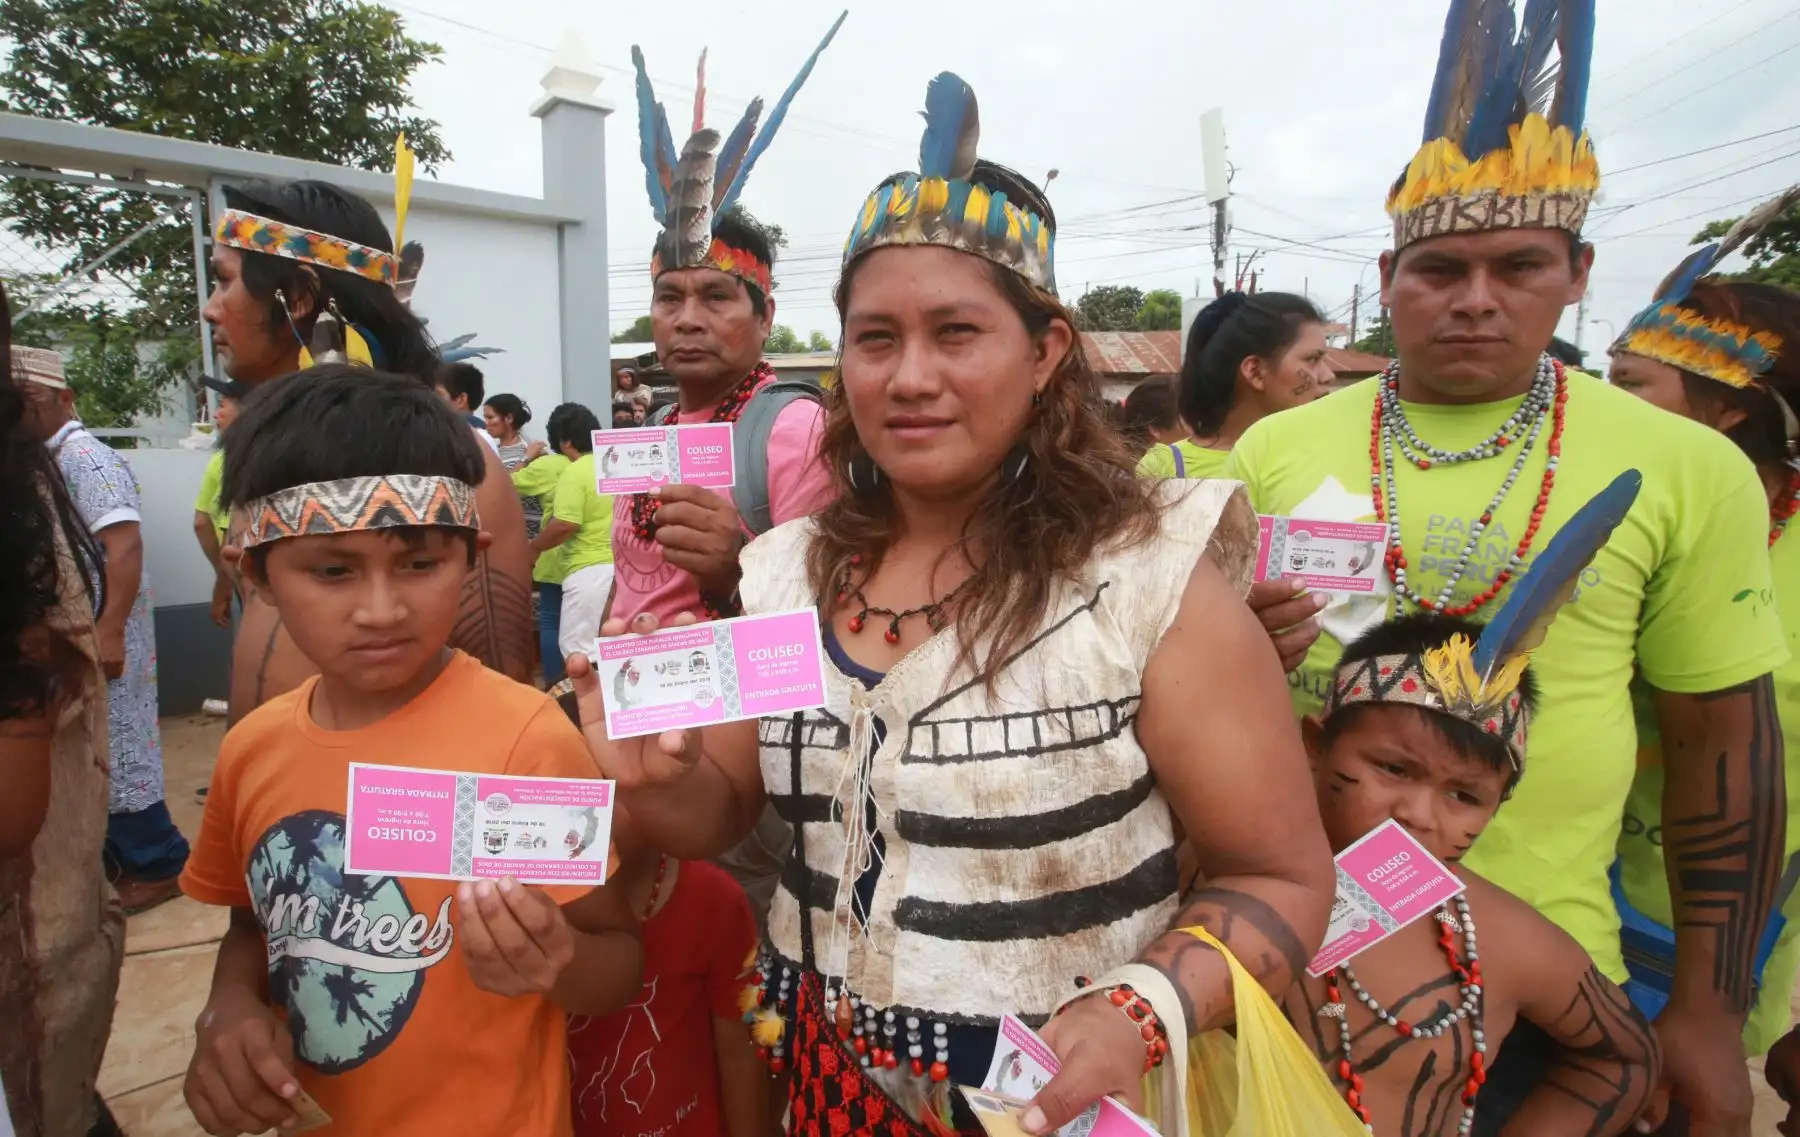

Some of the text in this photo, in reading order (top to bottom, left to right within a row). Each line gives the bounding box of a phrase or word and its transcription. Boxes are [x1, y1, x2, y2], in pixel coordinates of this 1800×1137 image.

[687, 445, 723, 455] COLISEO
[748, 644, 804, 662] COLISEO
[744, 682, 818, 700] ENTRADA GRATUITA
[360, 785, 449, 799] ENTRADA GRATUITA
[368, 826, 436, 842] COLISEO
[1367, 851, 1411, 882] COLISEO
[1388, 874, 1444, 912] ENTRADA GRATUITA
[330, 894, 454, 956] trees
